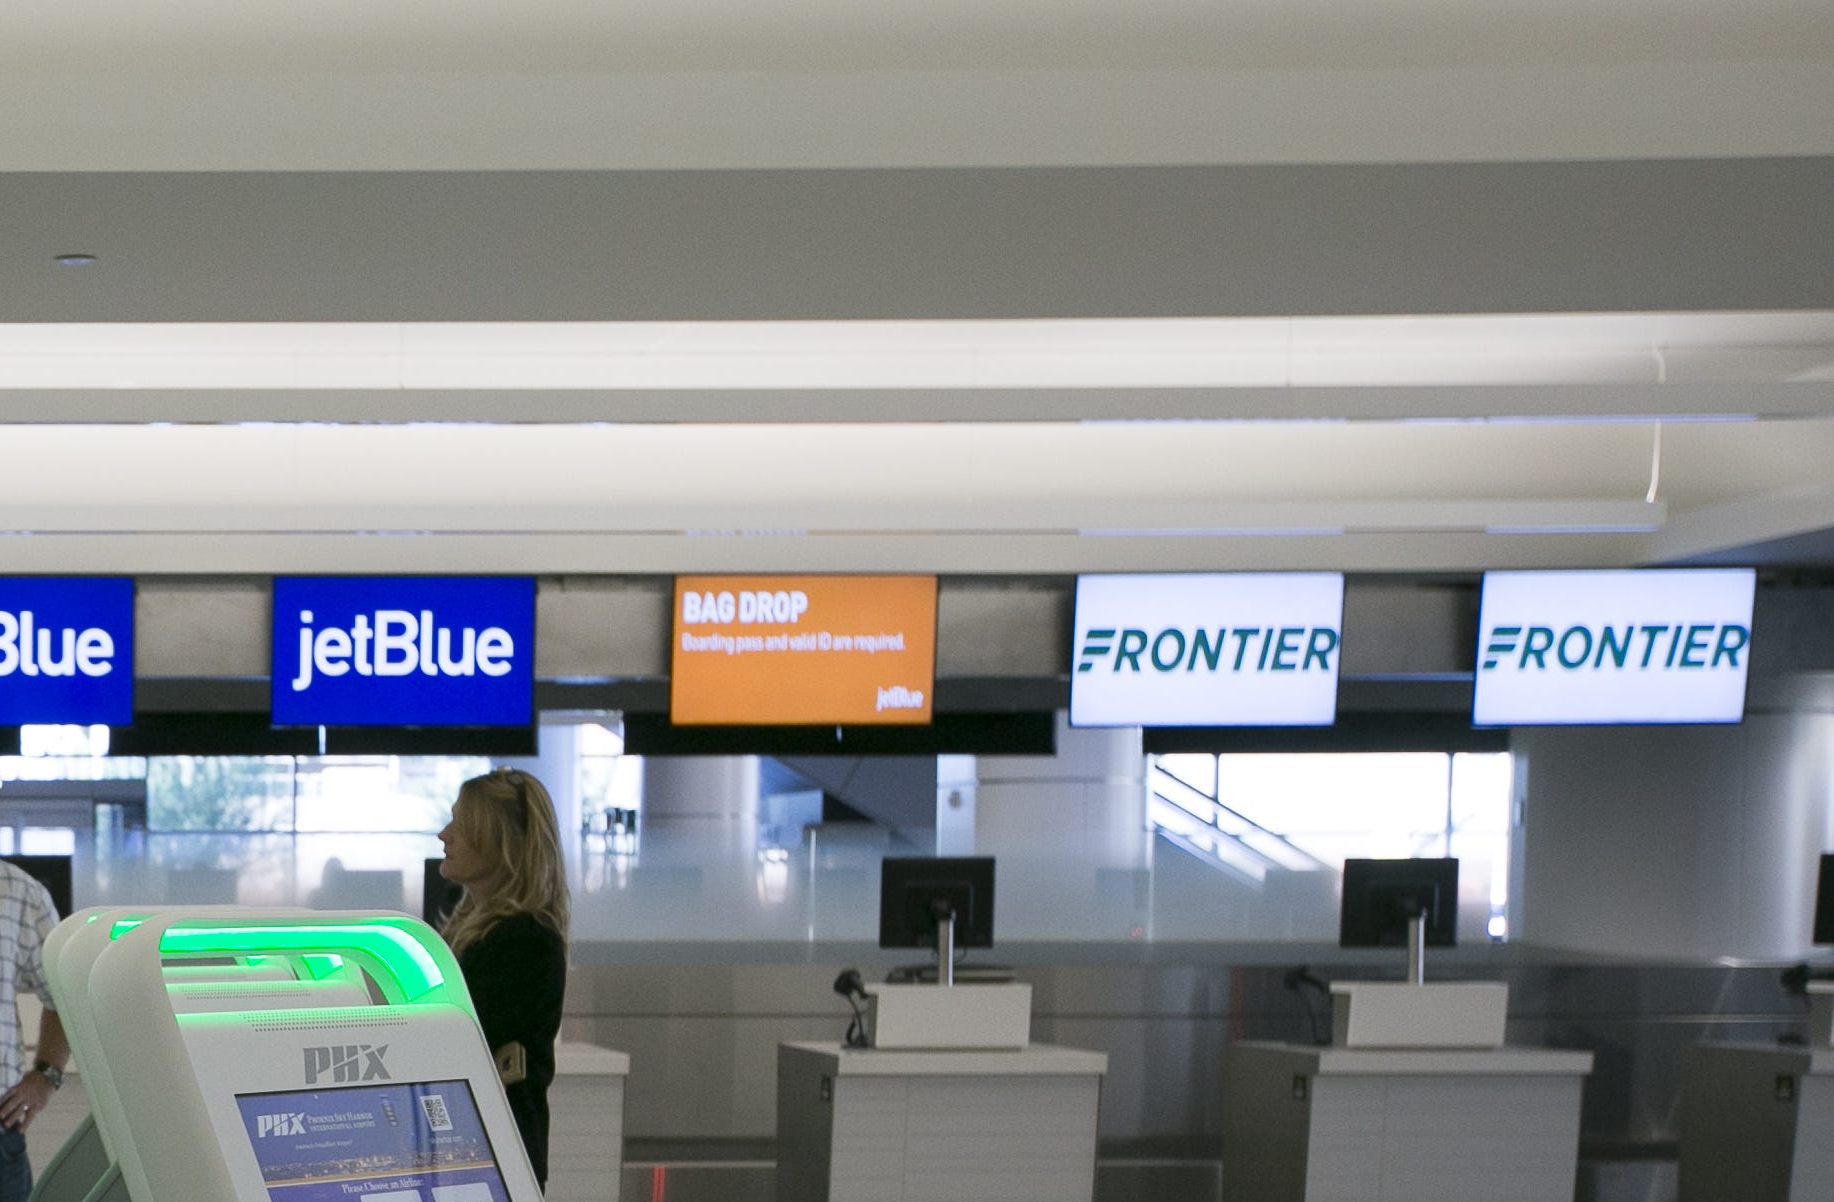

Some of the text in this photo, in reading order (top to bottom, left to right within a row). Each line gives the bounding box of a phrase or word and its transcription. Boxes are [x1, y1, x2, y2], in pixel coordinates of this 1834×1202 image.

[682, 590, 808, 624] BAG DROP
[293, 611, 513, 691] jetBlue
[681, 632, 735, 656] Boarding
[736, 635, 764, 656] pass
[765, 632, 788, 651] and
[789, 631, 816, 651] valid
[817, 631, 832, 651] ID
[832, 635, 853, 651] are
[1078, 627, 1338, 672] FRONTIER
[1483, 624, 1749, 669] FRONTIER
[876, 685, 924, 712] jetBlue
[303, 1044, 392, 1084] PHX
[257, 1112, 306, 1138] PHX
[341, 1183, 364, 1194] Please
[364, 1181, 390, 1192] Choose
